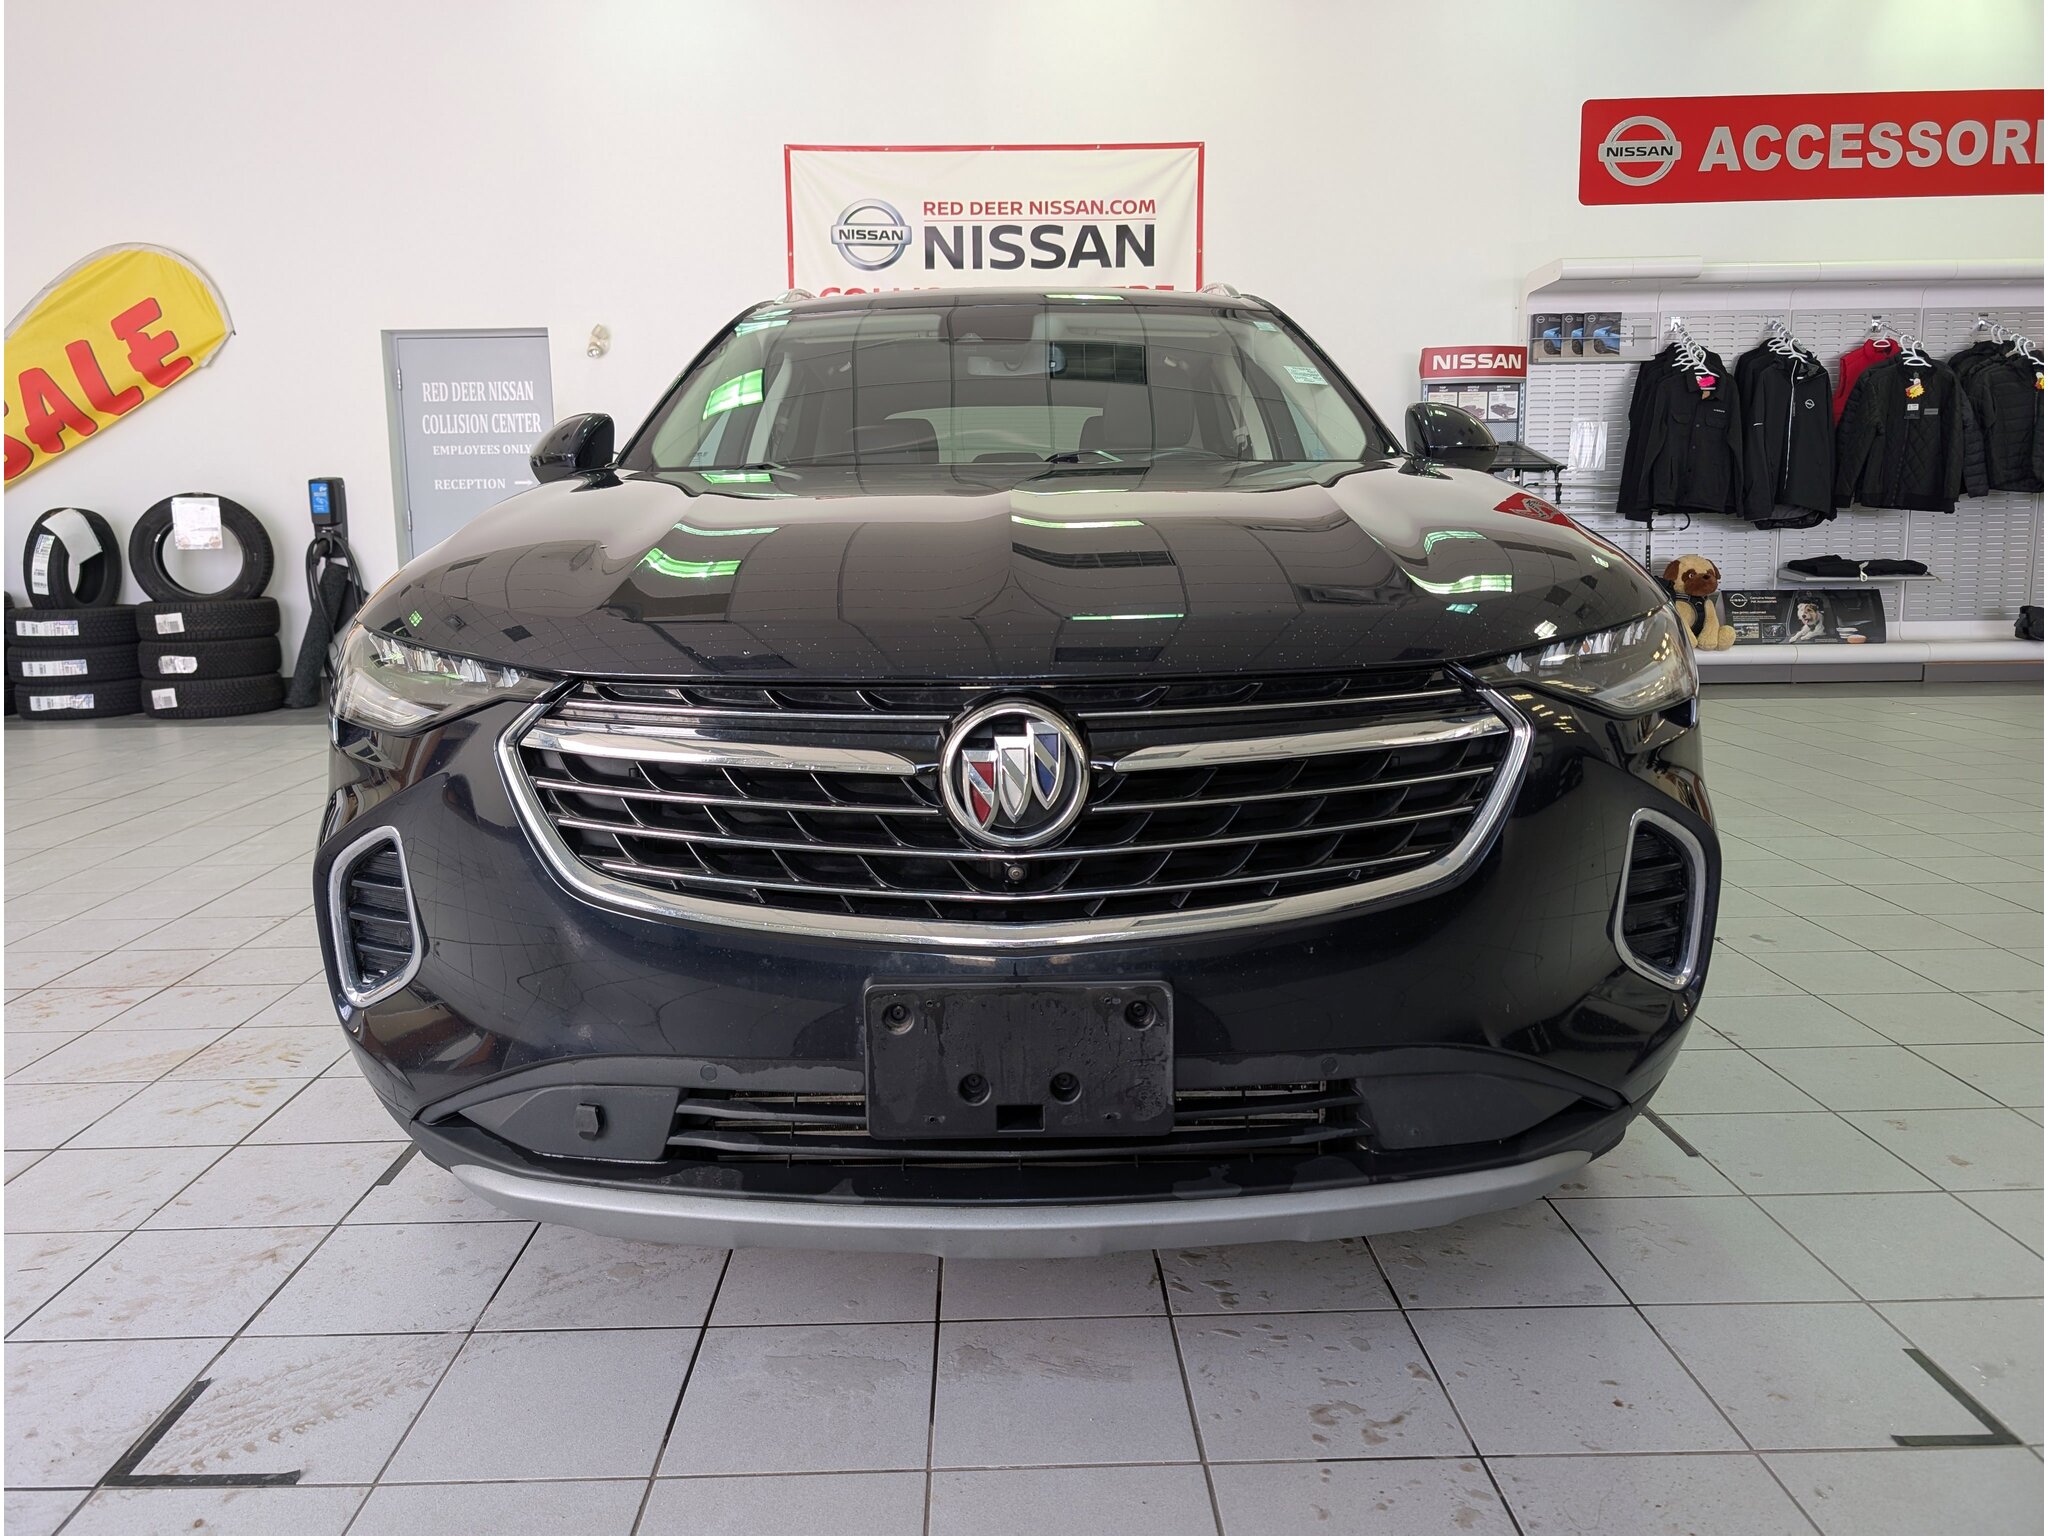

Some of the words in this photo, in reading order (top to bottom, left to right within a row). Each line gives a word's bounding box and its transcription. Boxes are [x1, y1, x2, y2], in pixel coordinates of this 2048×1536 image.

[1605, 145, 1674, 158] NISSAN
[923, 201, 963, 216] RED
[970, 200, 1023, 215] DEER
[1029, 198, 1156, 215] NISSAN.COM
[838, 229, 904, 241] NISSAN
[924, 223, 1155, 270] NISSAN
[1432, 353, 1522, 371] NISSAN
[422, 382, 448, 402] RED
[452, 381, 486, 402] DEER
[489, 380, 534, 401] NISSAN
[422, 414, 489, 434] COLLISION
[491, 413, 542, 433] CENTER
[433, 445, 500, 456] EMPLOYEES
[503, 444, 532, 455] ONLY
[434, 478, 506, 490] RECEPTION
